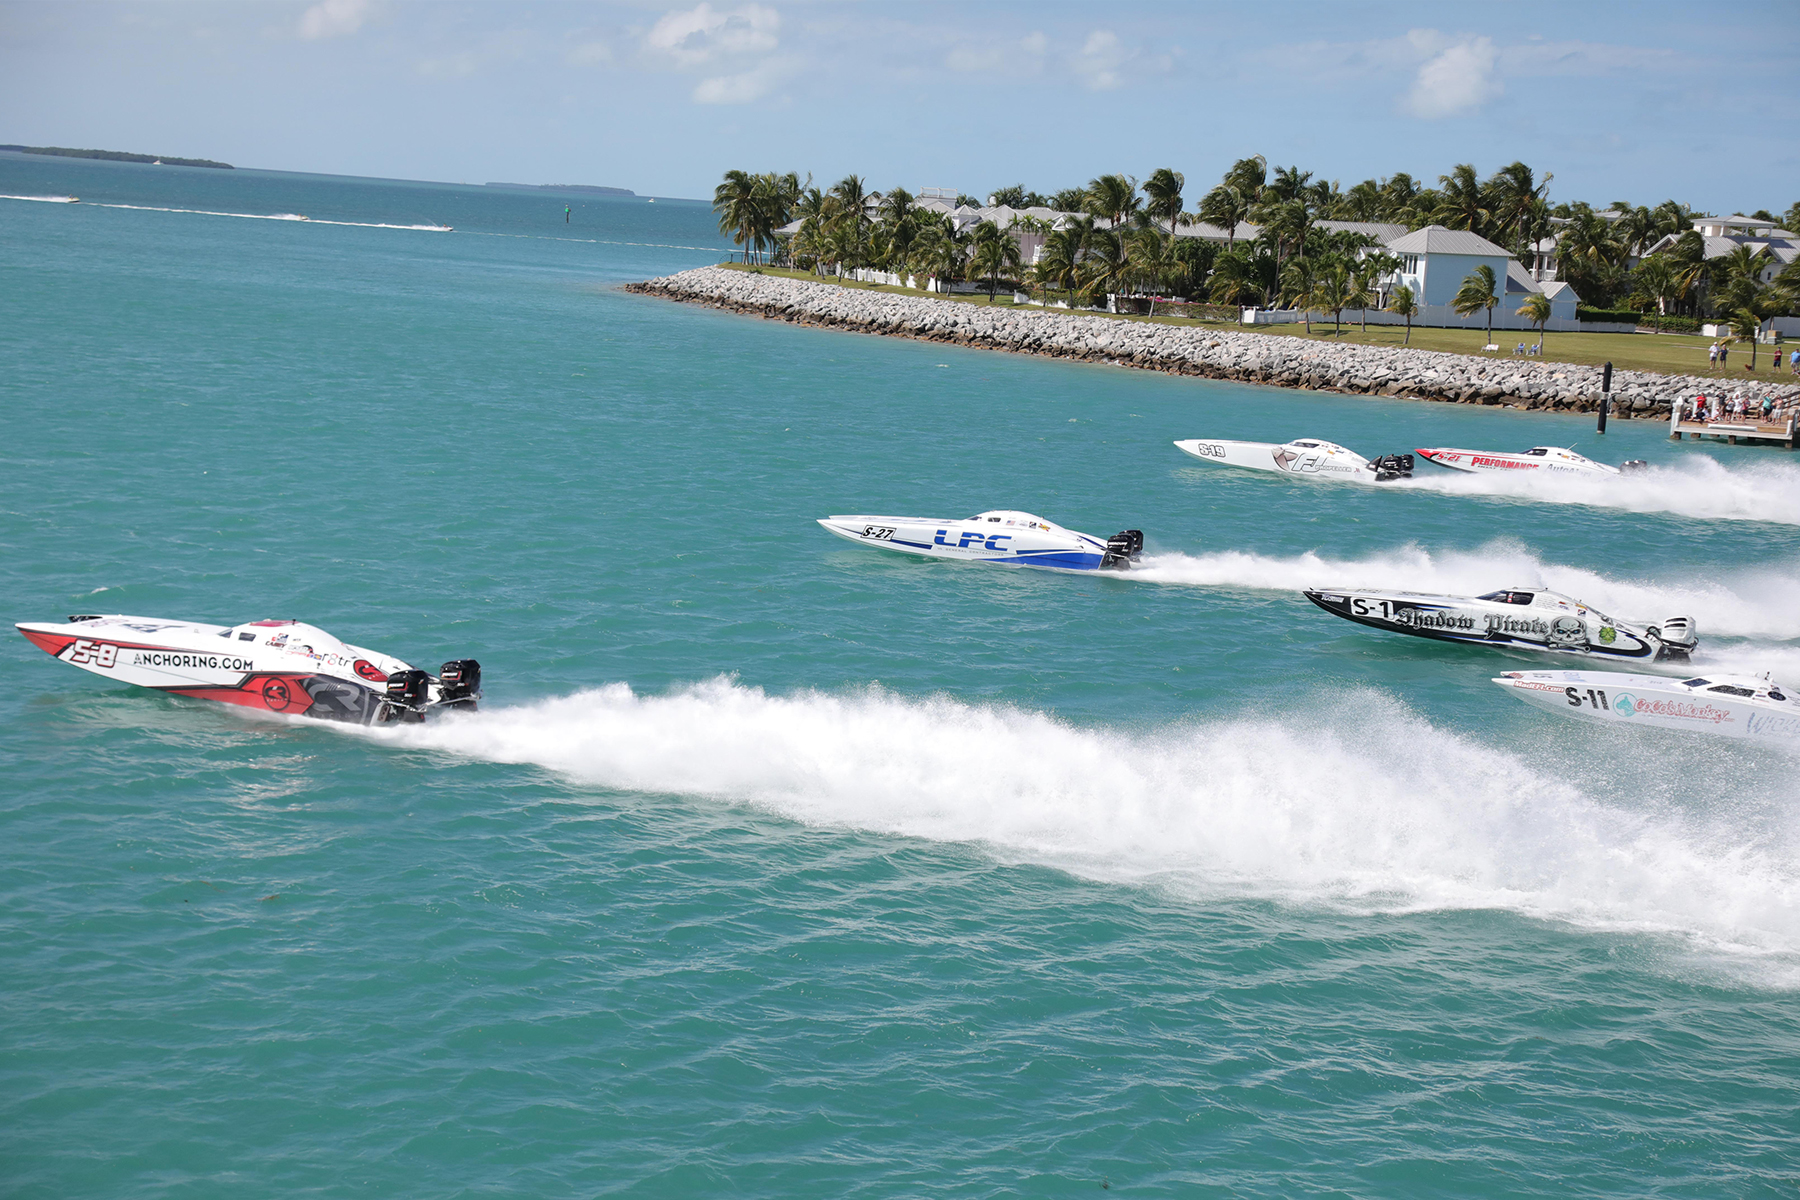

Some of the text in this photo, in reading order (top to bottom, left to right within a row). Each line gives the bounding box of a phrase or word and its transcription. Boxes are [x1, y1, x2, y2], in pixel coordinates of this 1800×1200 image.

[1198, 443, 1226, 458] S-19
[1436, 452, 1461, 462] S-21
[1471, 456, 1539, 471] PERFORMANCE
[862, 526, 893, 540] S-27
[933, 529, 1012, 552] LPC
[1353, 598, 1389, 619] S-1
[1394, 607, 1550, 640] Shadow Pirate
[70, 638, 119, 669] S-8
[133, 653, 253, 671] ANCHORING.COM
[1565, 686, 1610, 711] S-11
